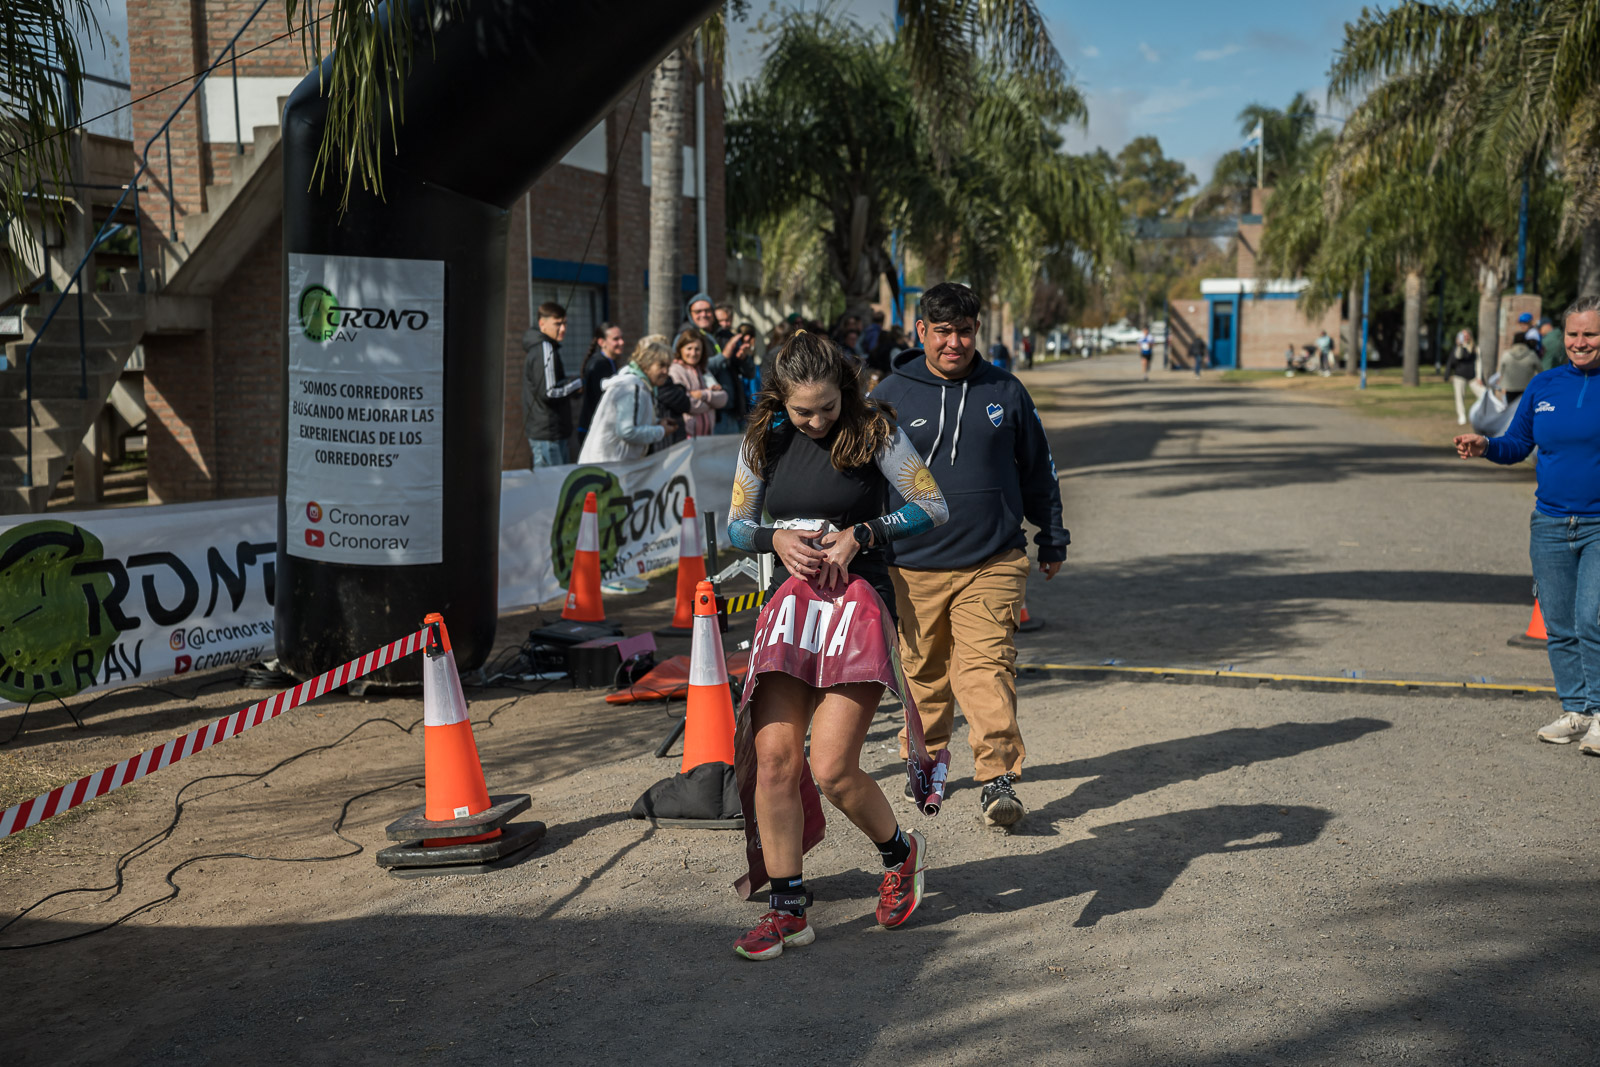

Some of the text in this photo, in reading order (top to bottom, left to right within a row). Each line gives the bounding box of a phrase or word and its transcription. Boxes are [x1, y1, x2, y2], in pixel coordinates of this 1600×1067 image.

[327, 306, 429, 331] CRONO
[324, 330, 358, 342] RAV
[340, 384, 424, 400] CORREDORES
[292, 401, 435, 423] BUSCANDO MEJORAR LAS
[300, 424, 423, 445] EXPERIENCIAS DE LOS
[329, 508, 410, 527] Cronorav
[329, 531, 410, 550] Cronorav
[72, 639, 143, 689] RAV
[194, 645, 264, 671] cronorav
